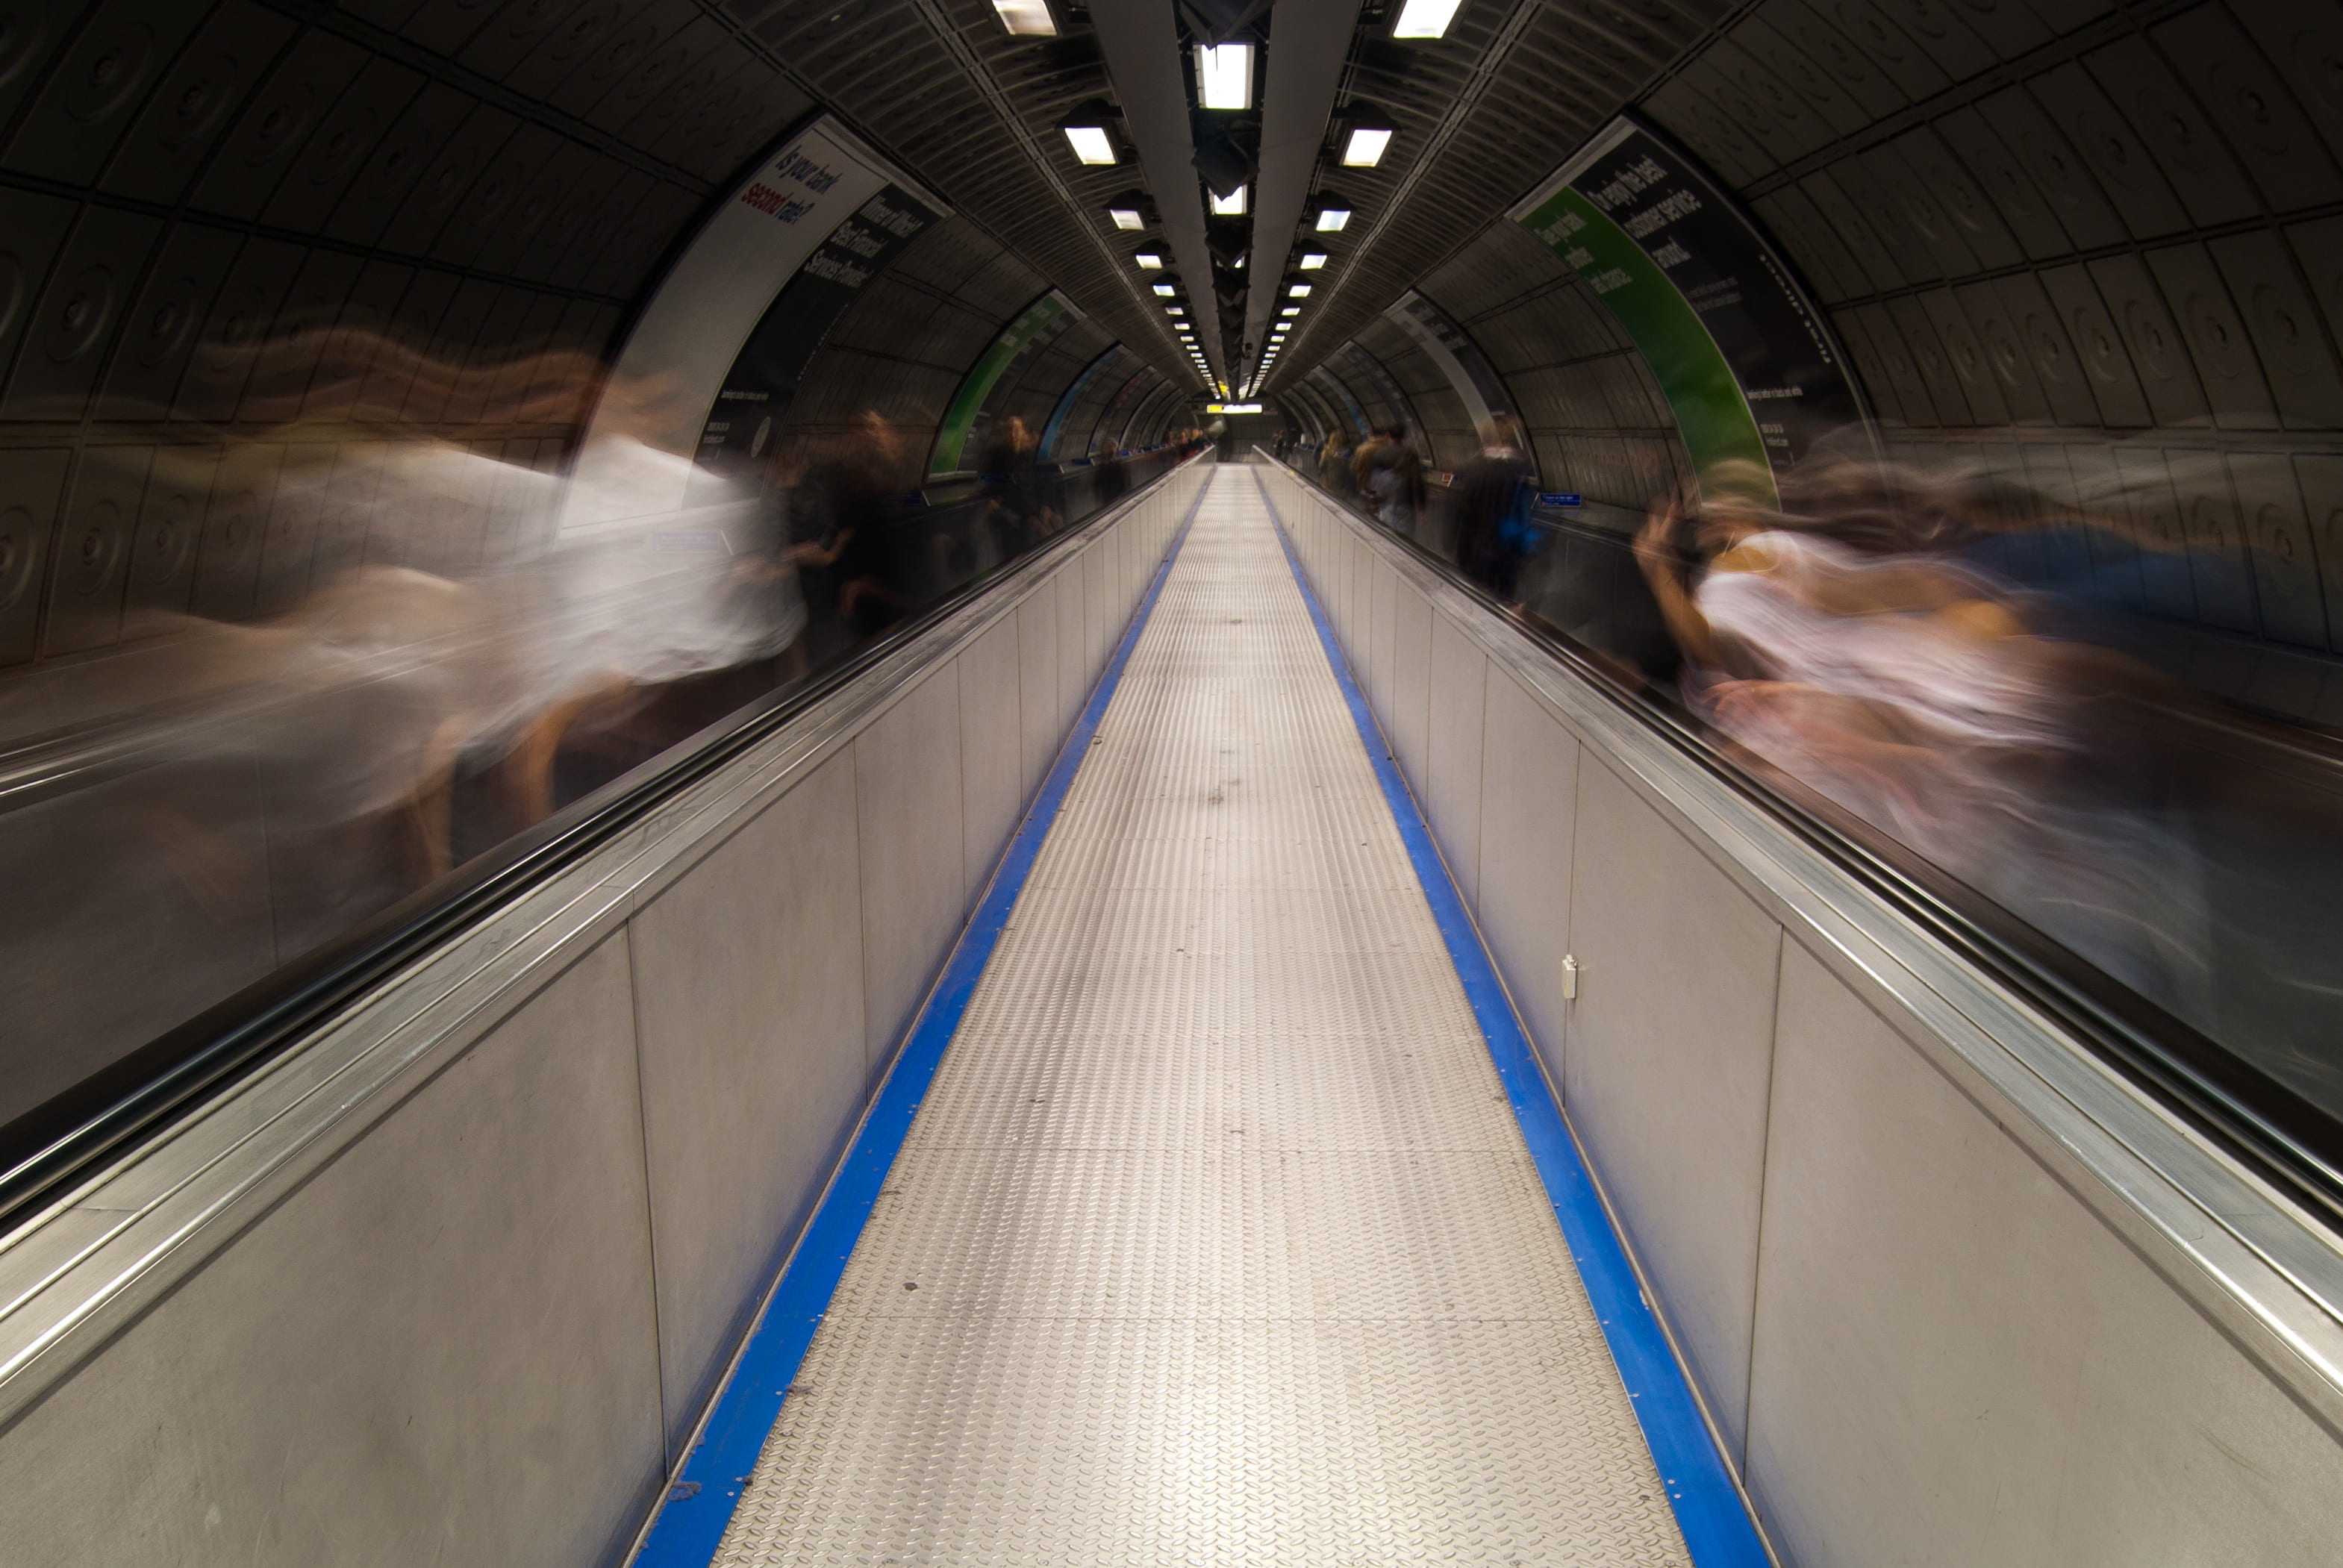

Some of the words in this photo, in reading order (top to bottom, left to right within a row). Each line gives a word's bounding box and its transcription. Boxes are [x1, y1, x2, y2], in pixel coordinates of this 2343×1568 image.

[775, 144, 802, 170] Is
[779, 156, 819, 179] your
[1626, 153, 1668, 185] best
[805, 163, 843, 195] bank
[1614, 169, 1647, 193] the
[740, 182, 794, 215] second
[830, 220, 862, 248] Best
[1623, 206, 1669, 240] customer
[803, 249, 845, 281] Services
